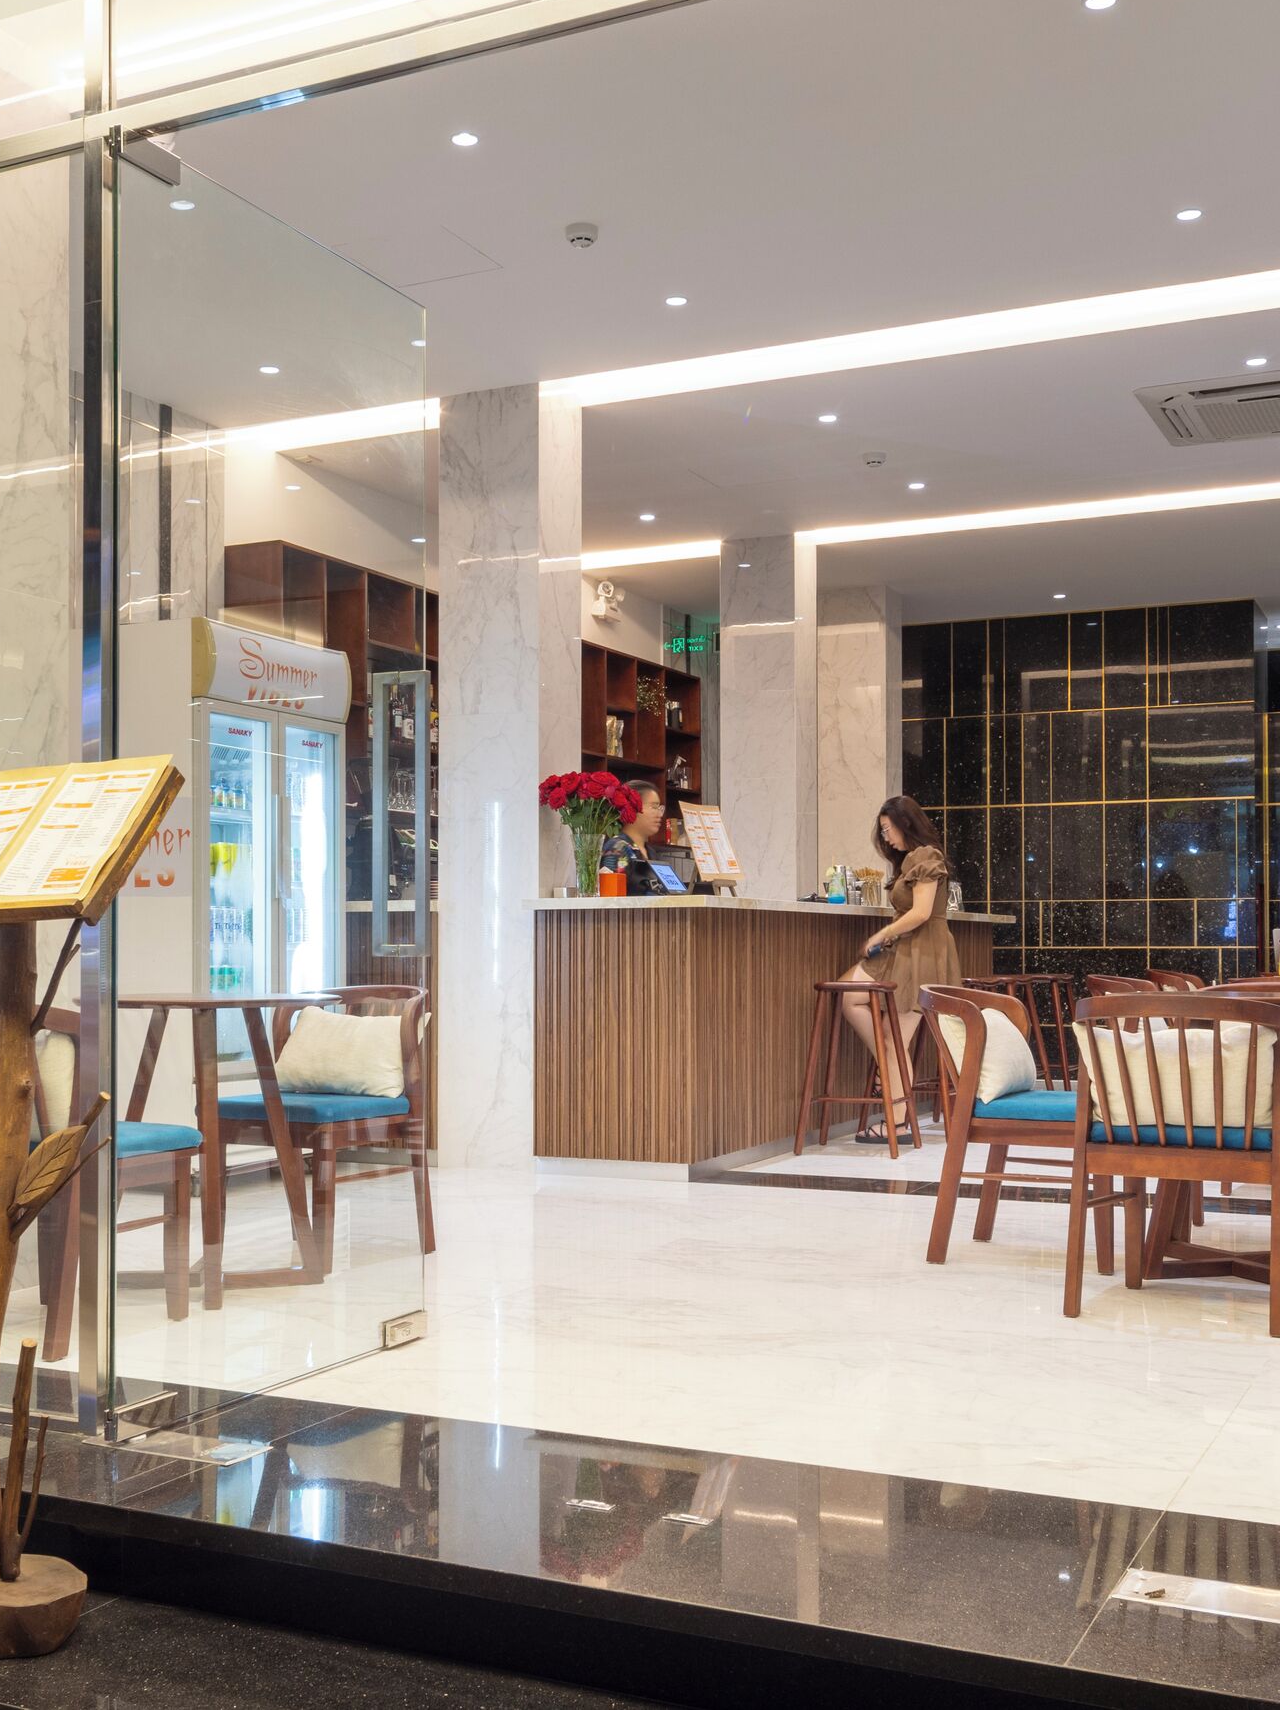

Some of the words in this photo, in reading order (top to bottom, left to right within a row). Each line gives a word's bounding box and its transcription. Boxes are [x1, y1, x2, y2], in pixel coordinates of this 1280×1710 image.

[239, 637, 318, 689] Summer
[228, 727, 252, 738] SANAKY
[301, 739, 324, 749] SANAKY
